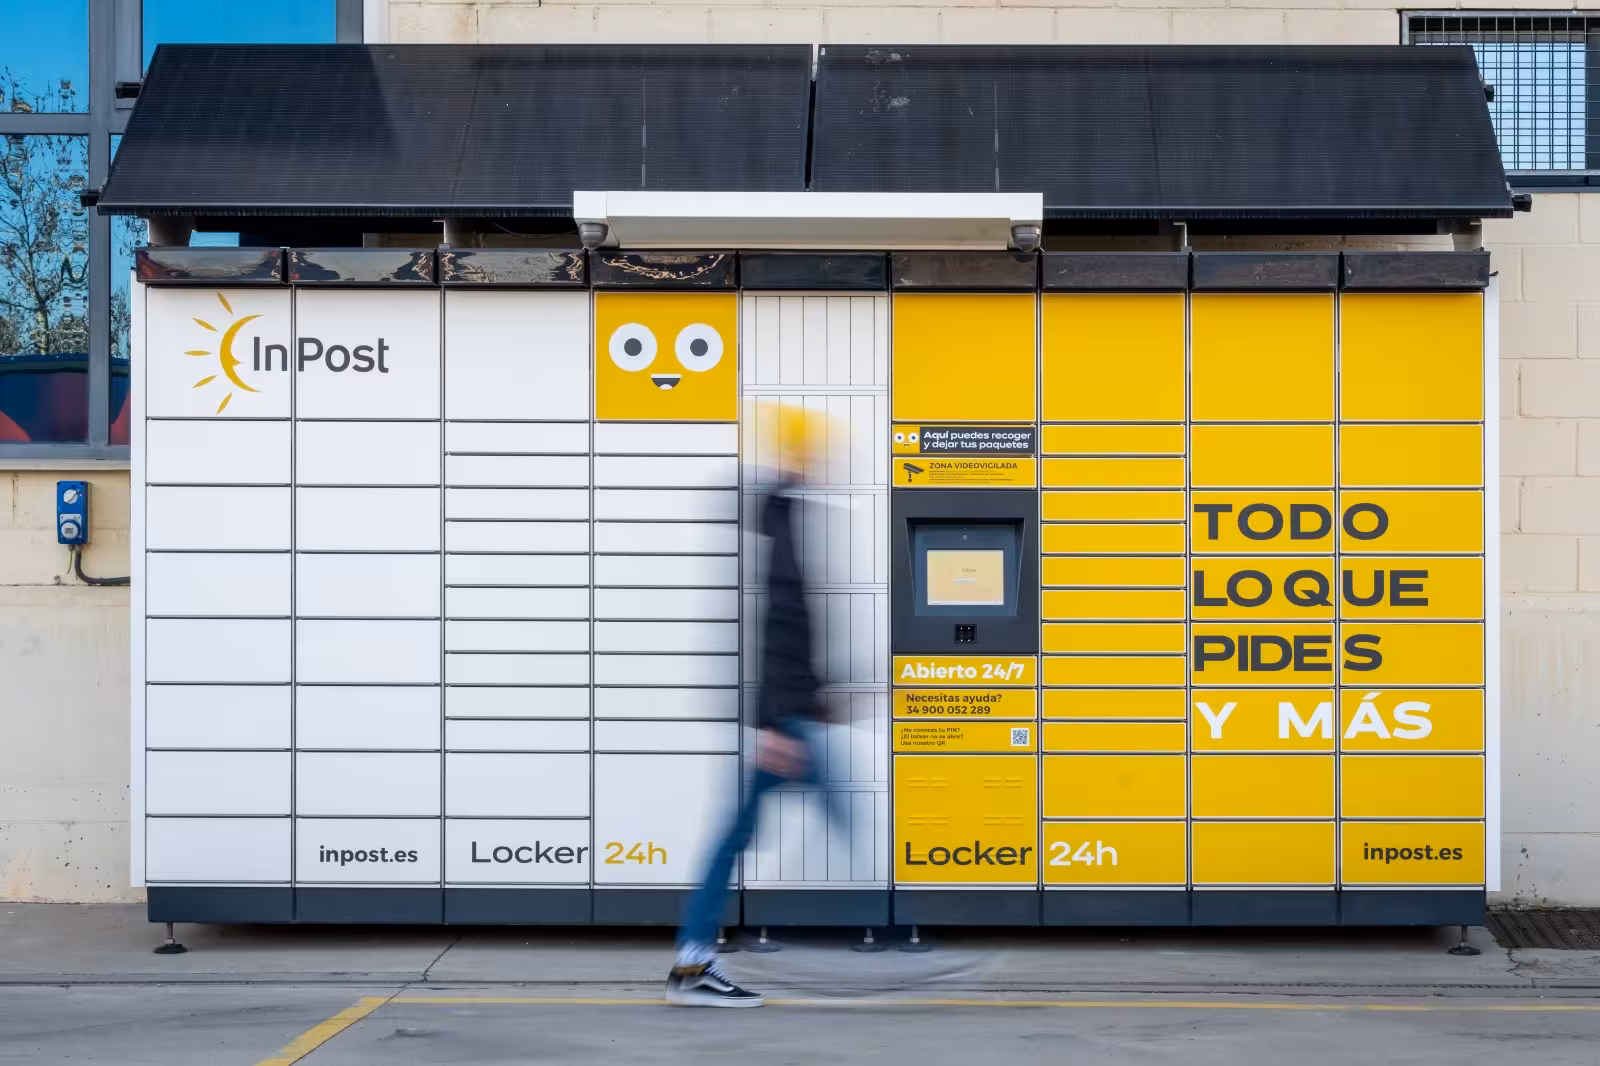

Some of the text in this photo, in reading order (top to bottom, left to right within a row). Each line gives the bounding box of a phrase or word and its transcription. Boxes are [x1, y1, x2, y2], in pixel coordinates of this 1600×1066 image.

[253, 336, 390, 373] InPost
[924, 431, 1031, 442] Aquí puedes recoger
[924, 441, 930, 450] y
[932, 441, 958, 449] dejar
[979, 442, 1028, 450] paquetes
[1194, 503, 1389, 540] TODO
[1194, 570, 1428, 607] LO QUE
[1194, 634, 1382, 672] PIDES
[900, 662, 1024, 680] Abierto 24/7
[906, 693, 1002, 704] Necesitas ayuda?
[906, 706, 990, 714] 34 900 052 289
[1194, 692, 1432, 739] Y MÁS
[319, 845, 418, 866] inpost.es
[471, 841, 667, 864] Locker 24h
[906, 840, 1118, 866] Locker 24h
[1364, 842, 1463, 864] inpost.es
